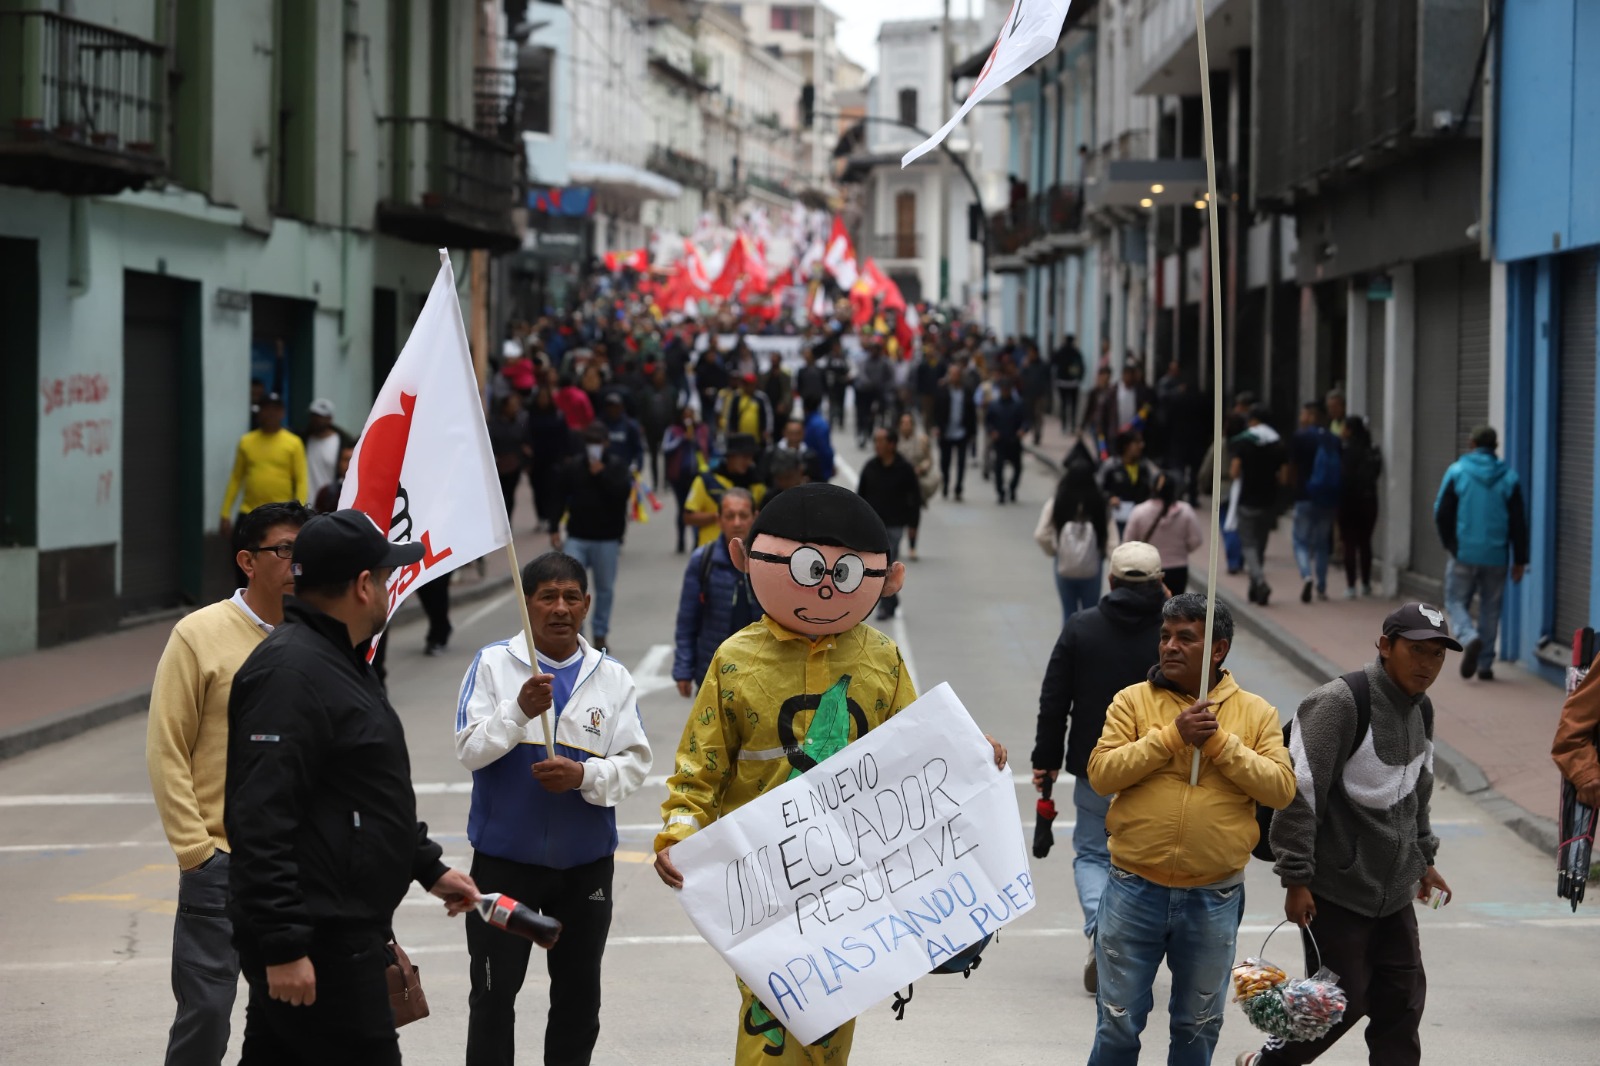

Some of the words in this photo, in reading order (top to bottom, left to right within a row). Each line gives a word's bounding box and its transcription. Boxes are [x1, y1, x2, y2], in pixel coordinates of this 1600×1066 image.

[778, 757, 960, 890] ECUADOR
[781, 798, 809, 828] EL
[808, 752, 879, 817] NUEVO
[795, 812, 979, 935] RESUELVE
[768, 871, 978, 1022] APLASTANDO
[926, 934, 968, 968] AL
